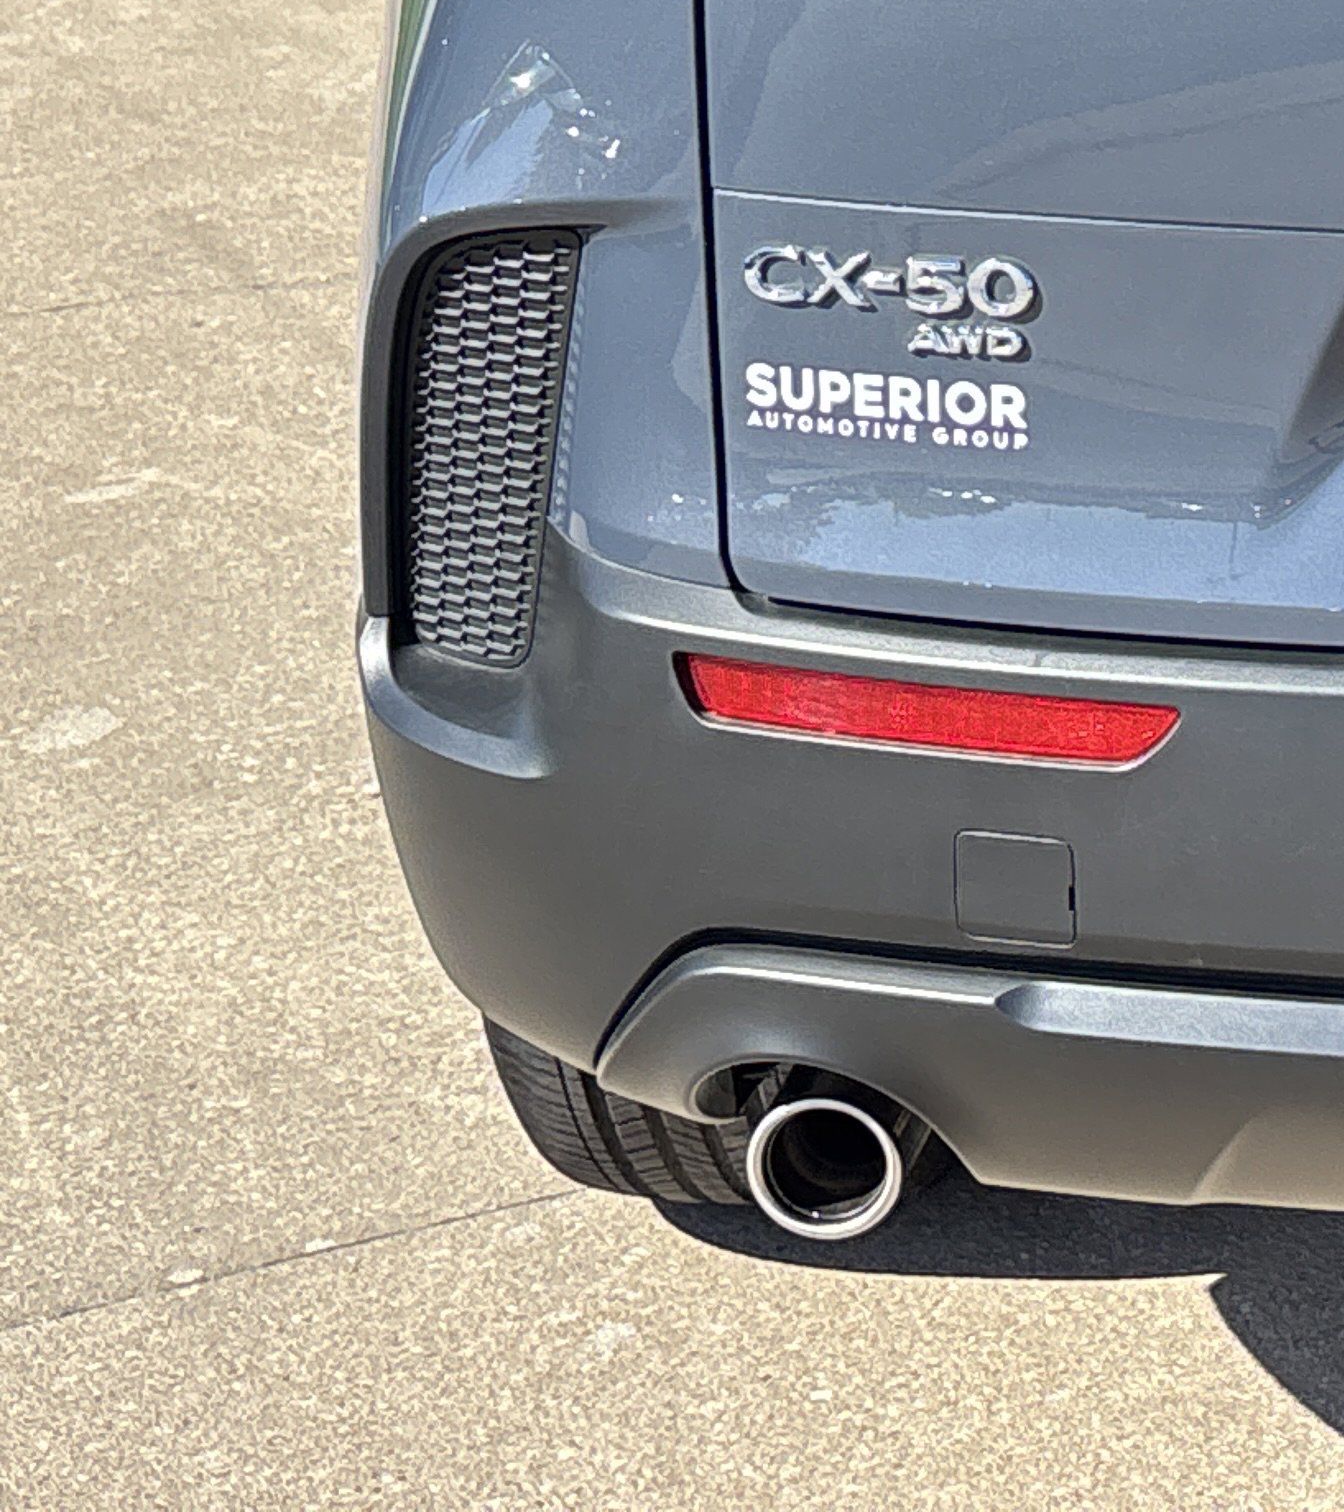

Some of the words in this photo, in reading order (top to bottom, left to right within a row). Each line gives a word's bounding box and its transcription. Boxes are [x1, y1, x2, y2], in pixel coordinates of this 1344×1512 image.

[743, 243, 1038, 319] CX-50
[906, 322, 1026, 358] AWD
[745, 361, 1029, 430] SUPERIOR
[746, 409, 918, 444] AUTOMOTIVE
[931, 425, 1030, 451] GROUP
